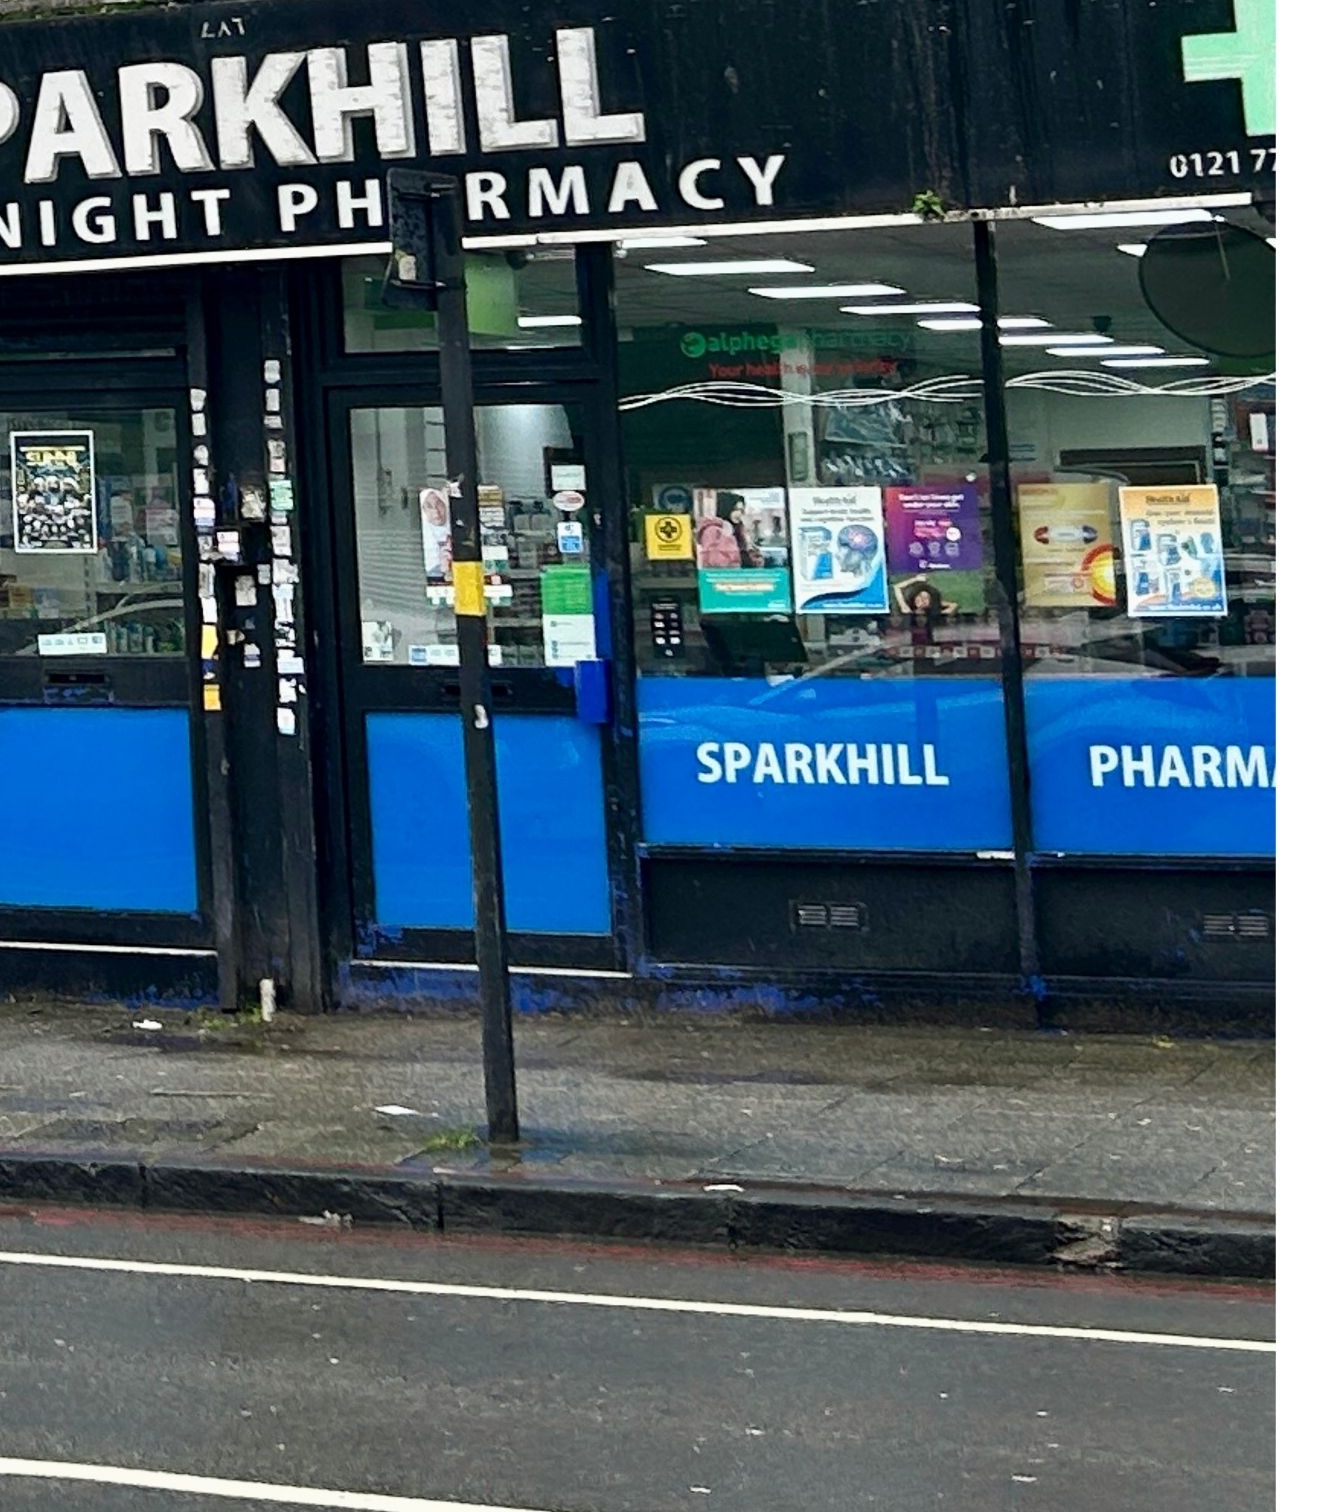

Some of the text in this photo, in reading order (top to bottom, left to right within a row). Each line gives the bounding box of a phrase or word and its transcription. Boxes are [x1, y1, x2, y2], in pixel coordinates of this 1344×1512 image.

[1170, 150, 1240, 178] 0121
[278, 151, 786, 232] PHRMACY
[696, 742, 949, 786] SPARKHILL
[1089, 745, 1276, 787] PHARM
